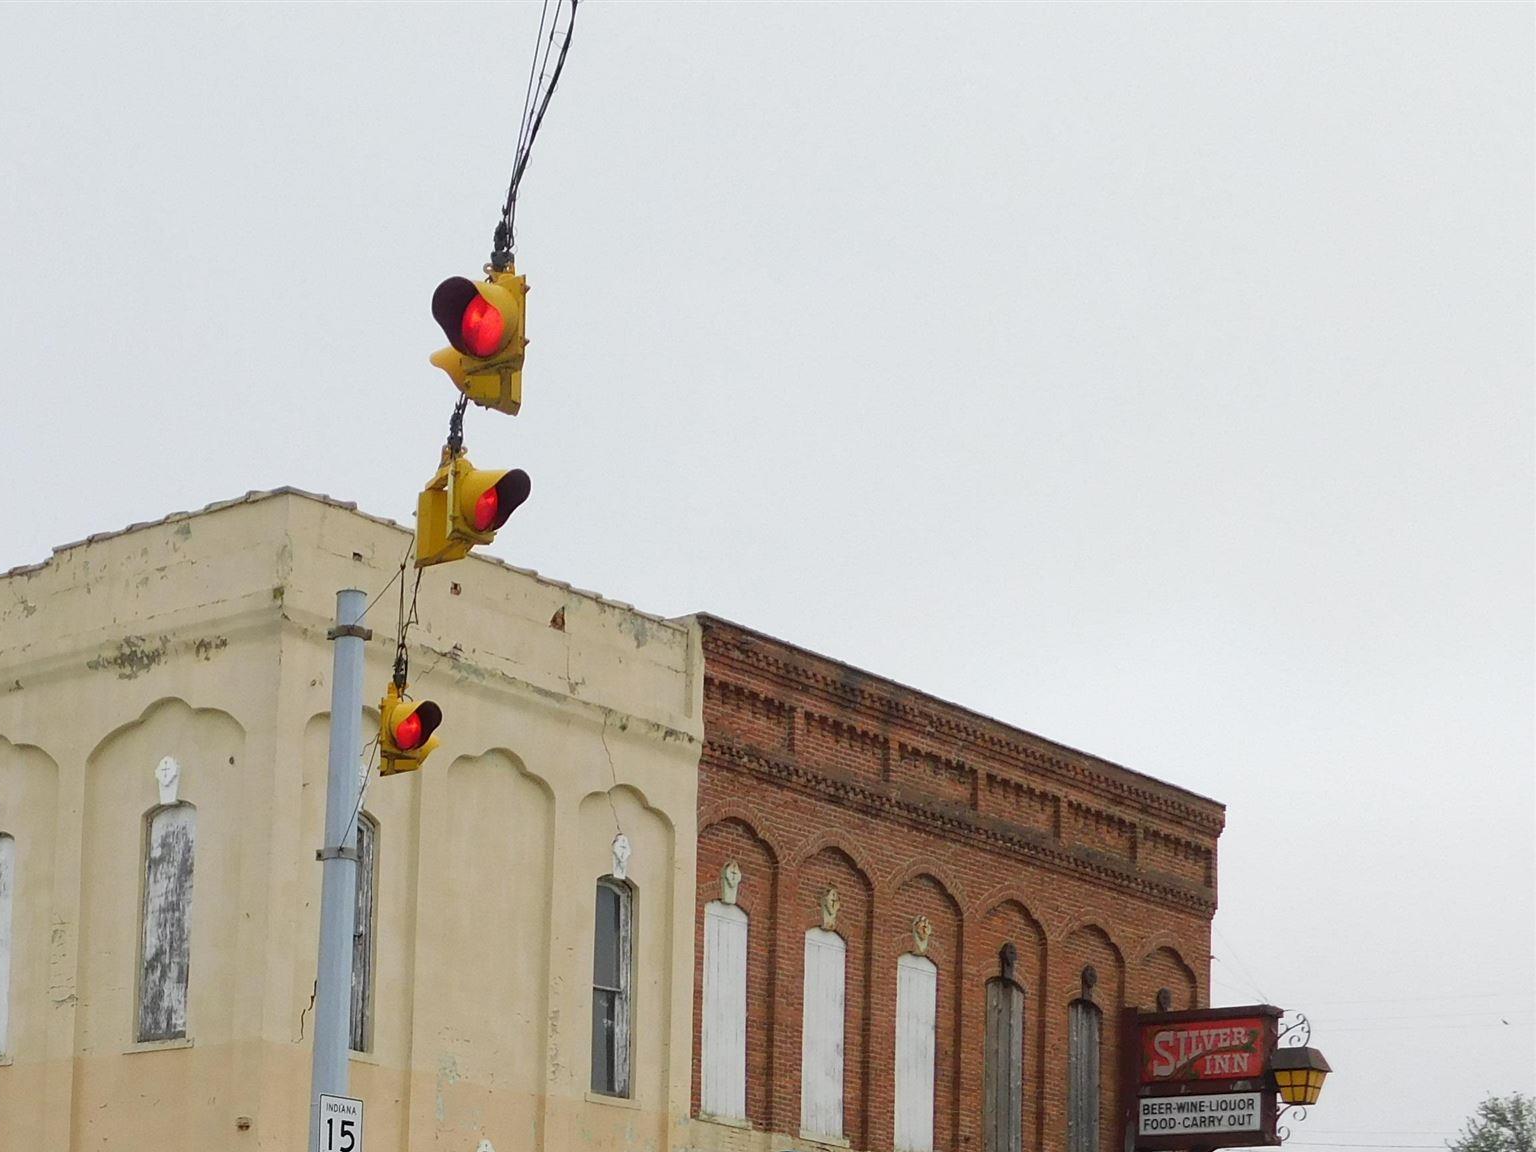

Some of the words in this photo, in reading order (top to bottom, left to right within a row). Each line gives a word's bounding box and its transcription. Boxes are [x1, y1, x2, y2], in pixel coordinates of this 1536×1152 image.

[1152, 1026, 1249, 1077] SILVER
[1204, 1052, 1250, 1075] INN
[325, 1102, 357, 1116] INDIANA
[1227, 1113, 1254, 1127] OUT
